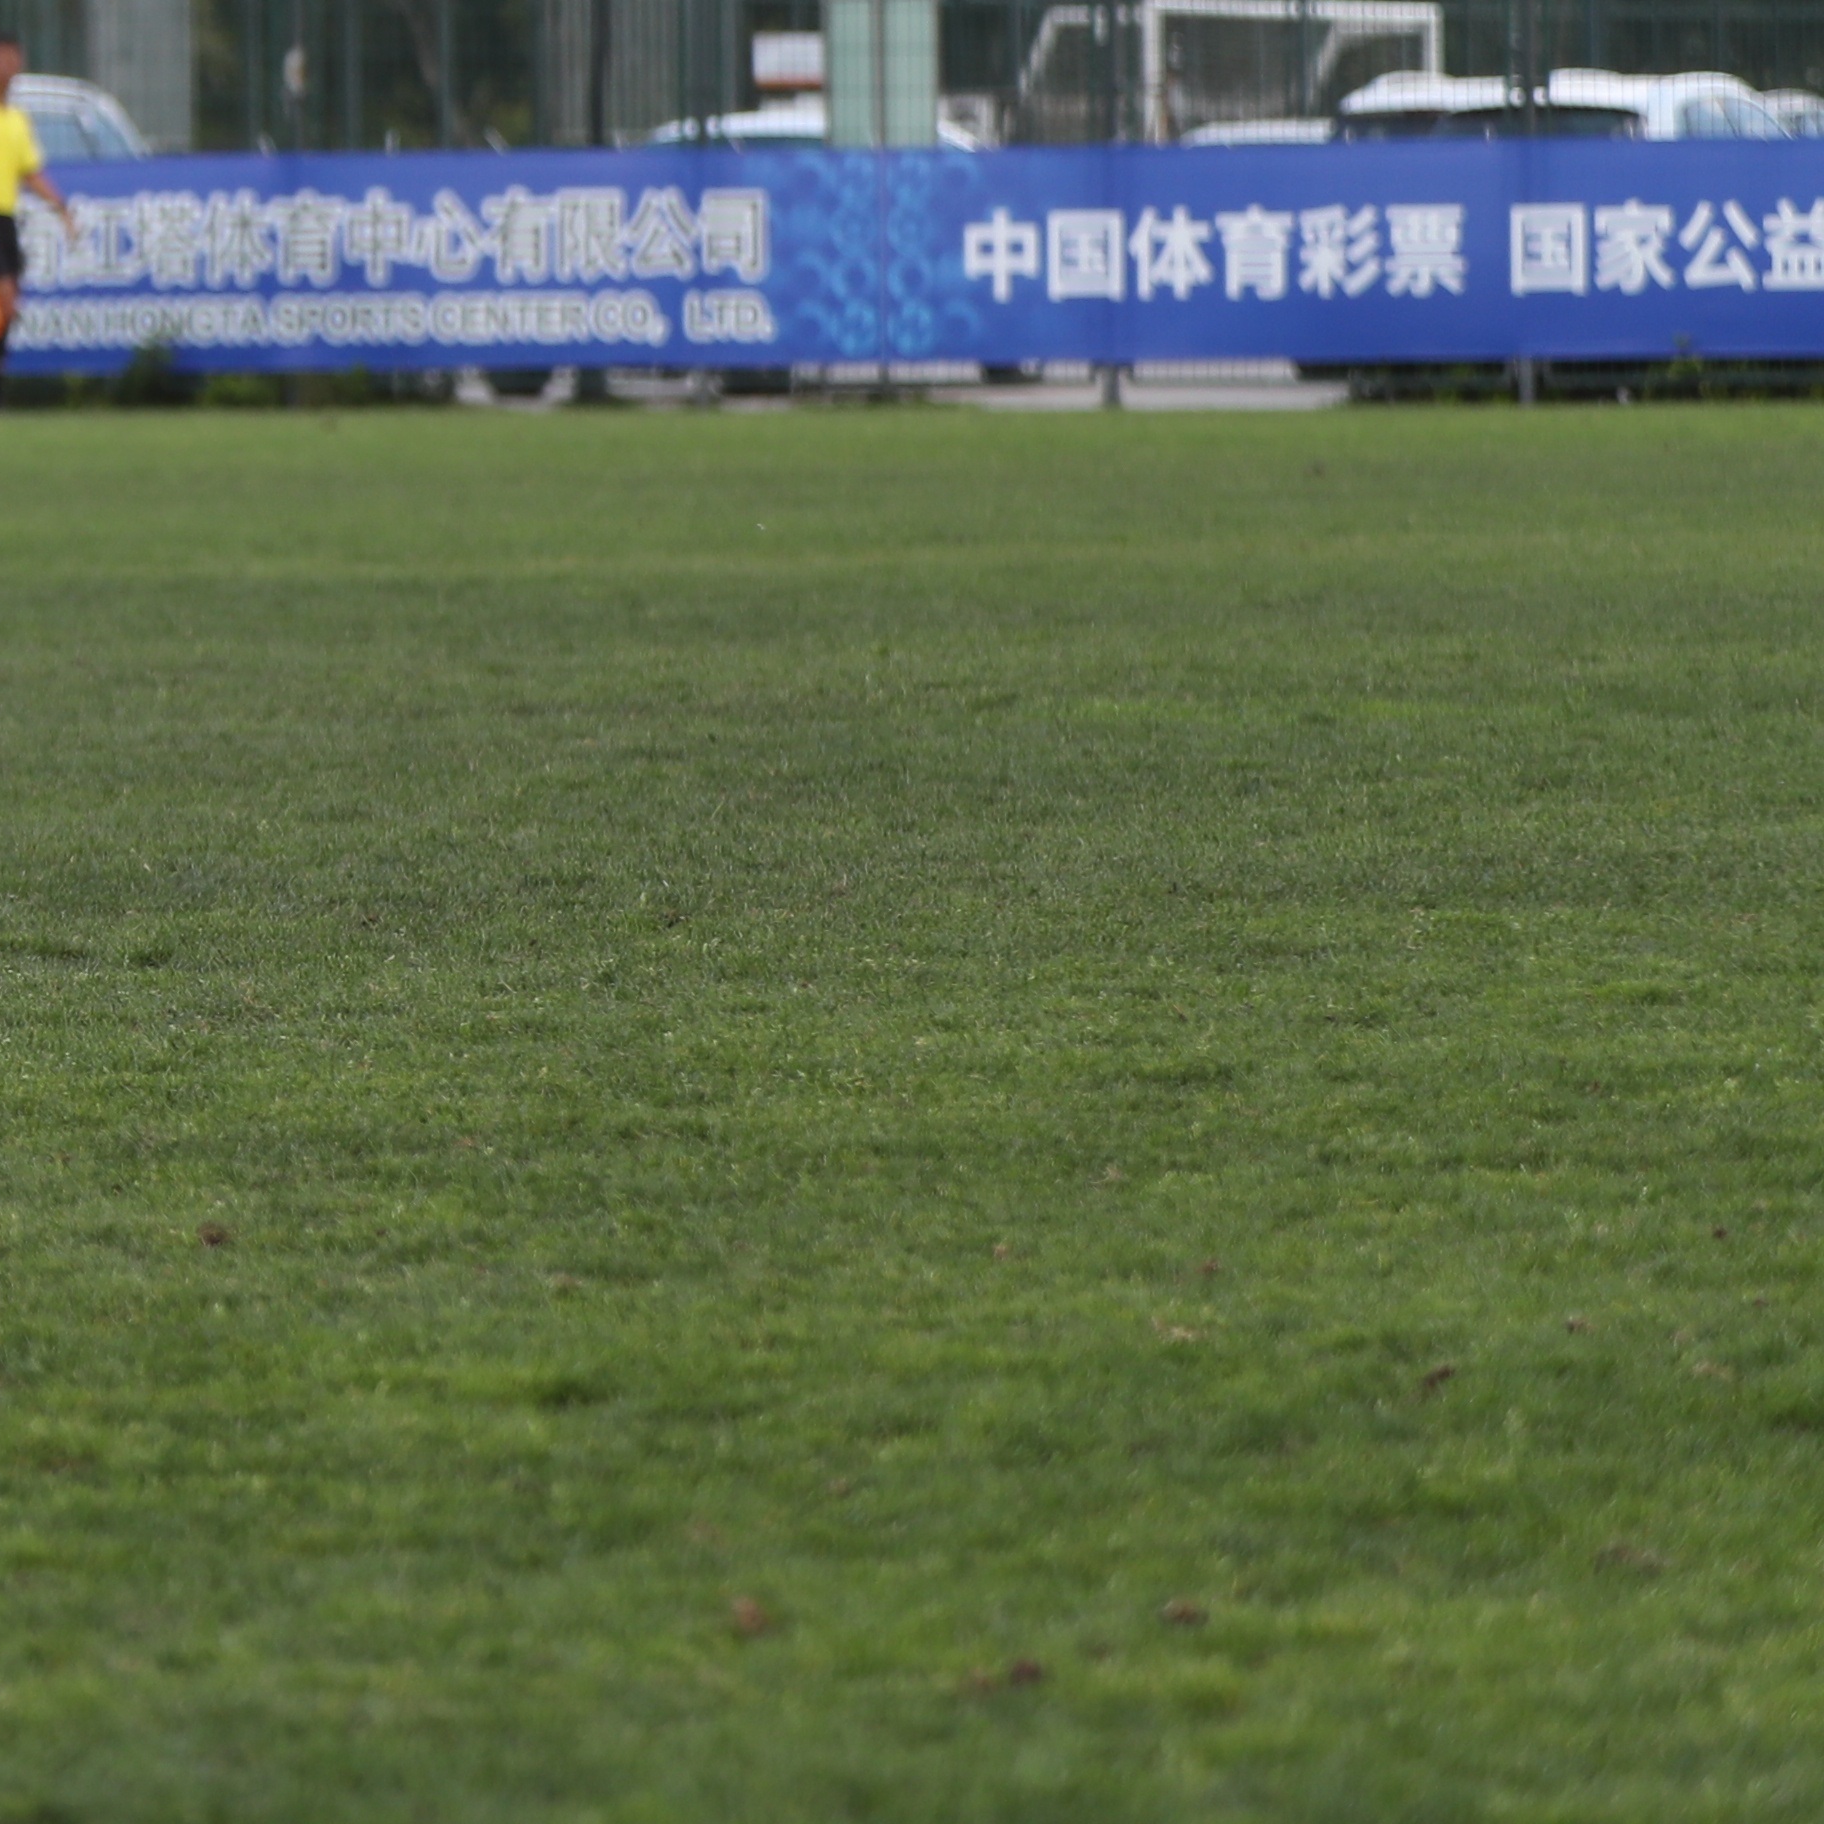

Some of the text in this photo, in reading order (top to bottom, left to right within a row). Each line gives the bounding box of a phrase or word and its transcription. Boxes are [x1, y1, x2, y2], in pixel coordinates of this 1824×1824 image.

[962, 203, 1466, 302] 中国体育彩票
